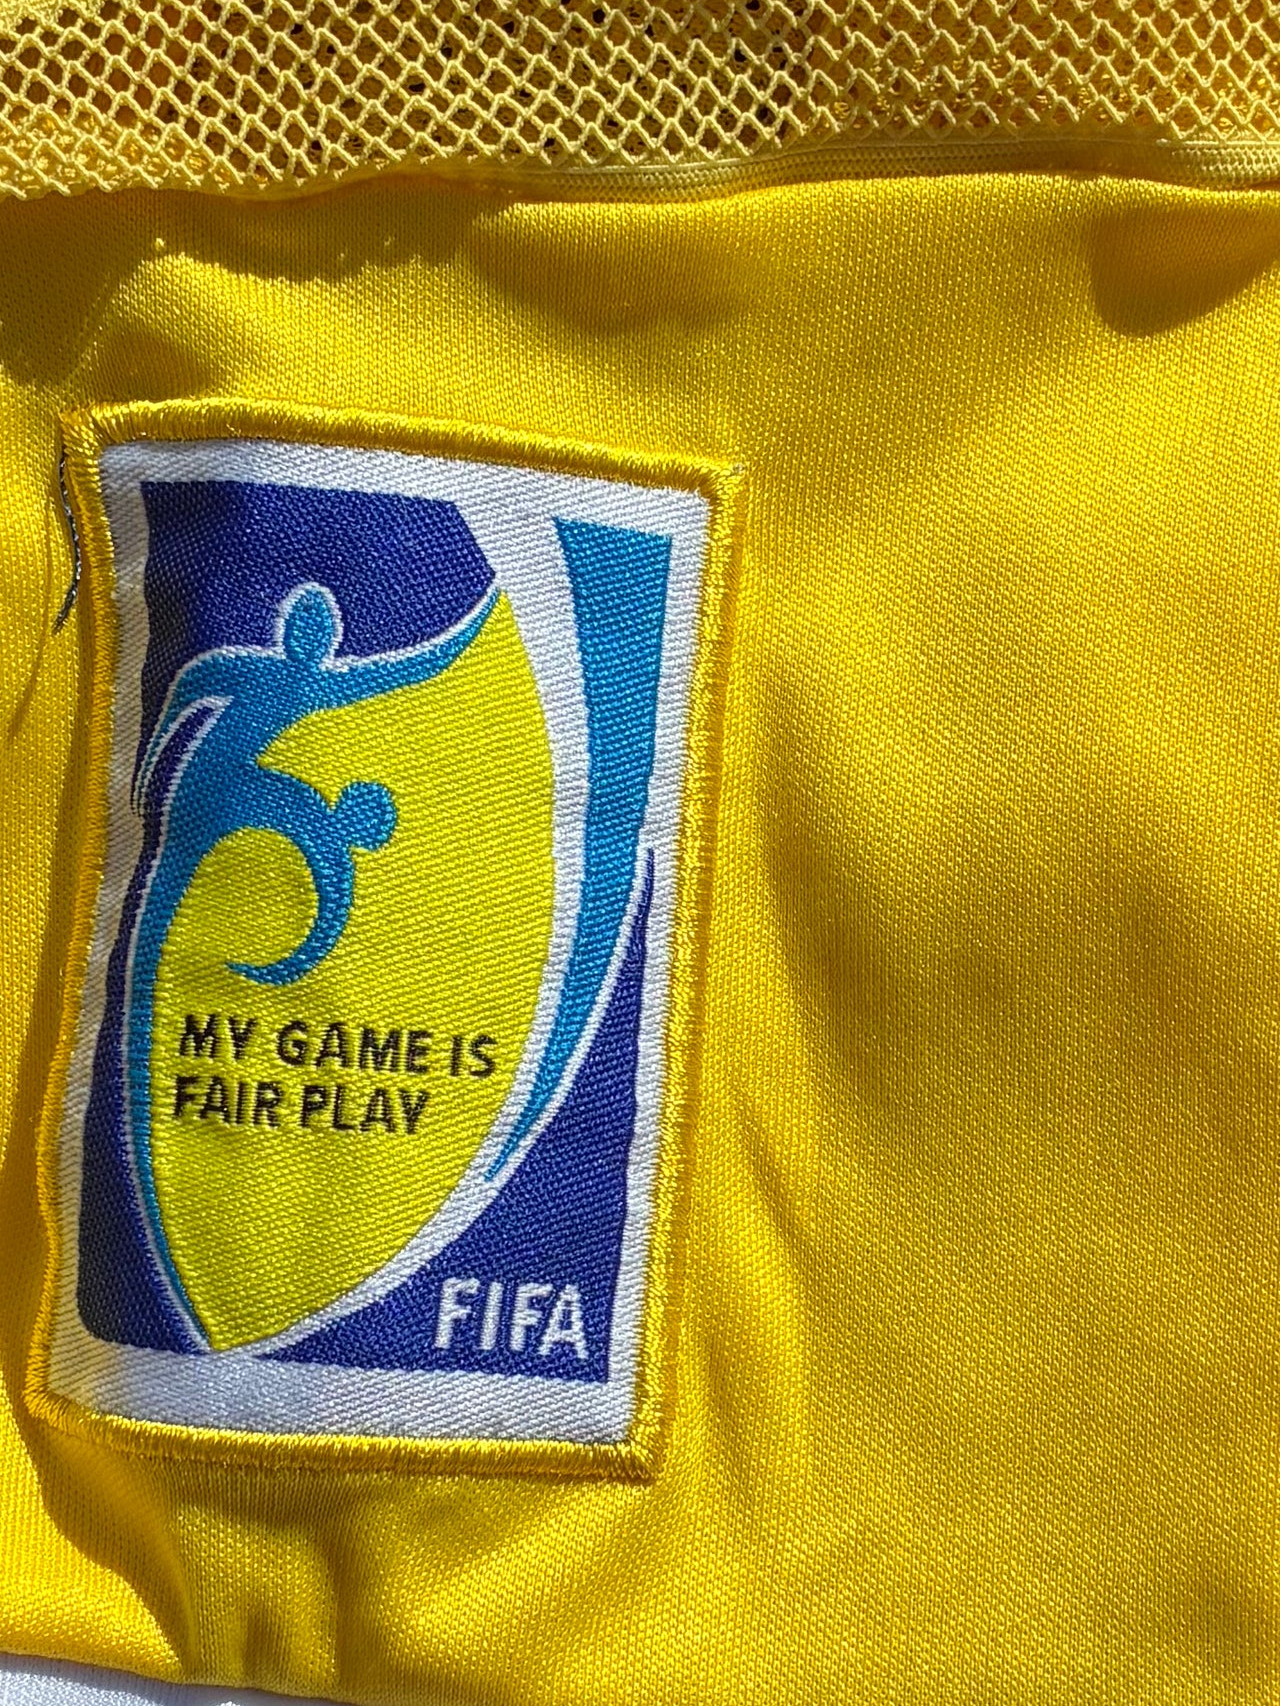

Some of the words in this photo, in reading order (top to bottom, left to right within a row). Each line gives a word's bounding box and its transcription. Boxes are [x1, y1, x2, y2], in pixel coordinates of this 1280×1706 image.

[178, 1013, 257, 1061] MY
[276, 1019, 434, 1075] GAME
[449, 1032, 498, 1079] IS
[173, 1073, 283, 1128] FAIR
[299, 1082, 431, 1135] PLAY
[432, 1277, 590, 1361] FIFA
